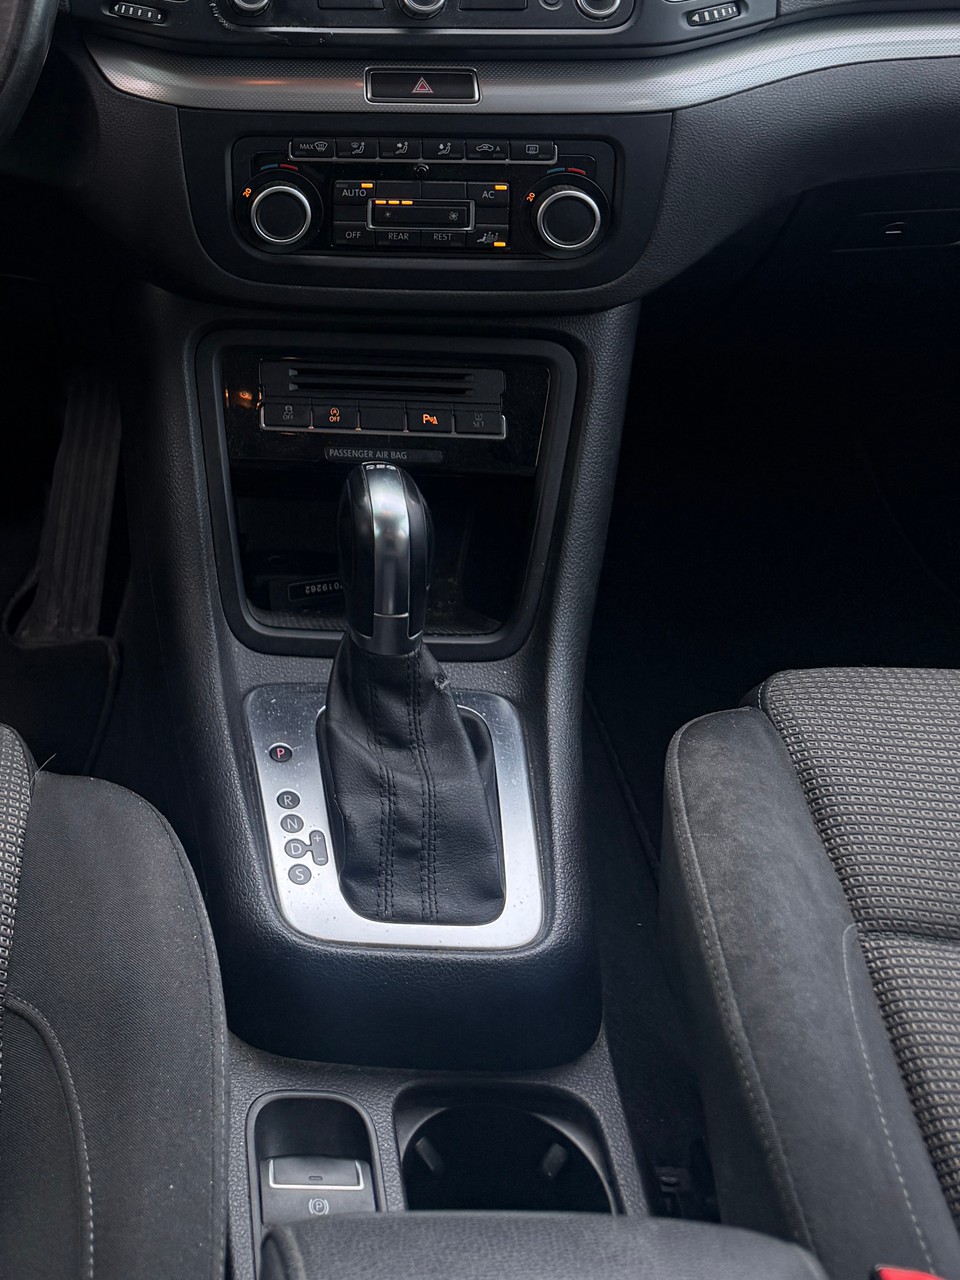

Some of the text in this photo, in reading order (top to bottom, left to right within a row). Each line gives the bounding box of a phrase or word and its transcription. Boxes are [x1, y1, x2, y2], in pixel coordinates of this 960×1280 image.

[242, 187, 252, 198] 20
[341, 189, 367, 197] AUTO
[481, 191, 495, 199] AC
[526, 192, 536, 202] 20
[345, 231, 362, 239] OFF
[388, 232, 410, 240] REAR
[433, 233, 453, 241] REST
[328, 415, 341, 423] OFF
[329, 448, 407, 460] PASSENGER AIR BAG
[276, 747, 285, 759] P
[283, 794, 293, 806] R
[286, 818, 299, 829] N
[290, 843, 302, 855] D
[295, 869, 305, 881] S
